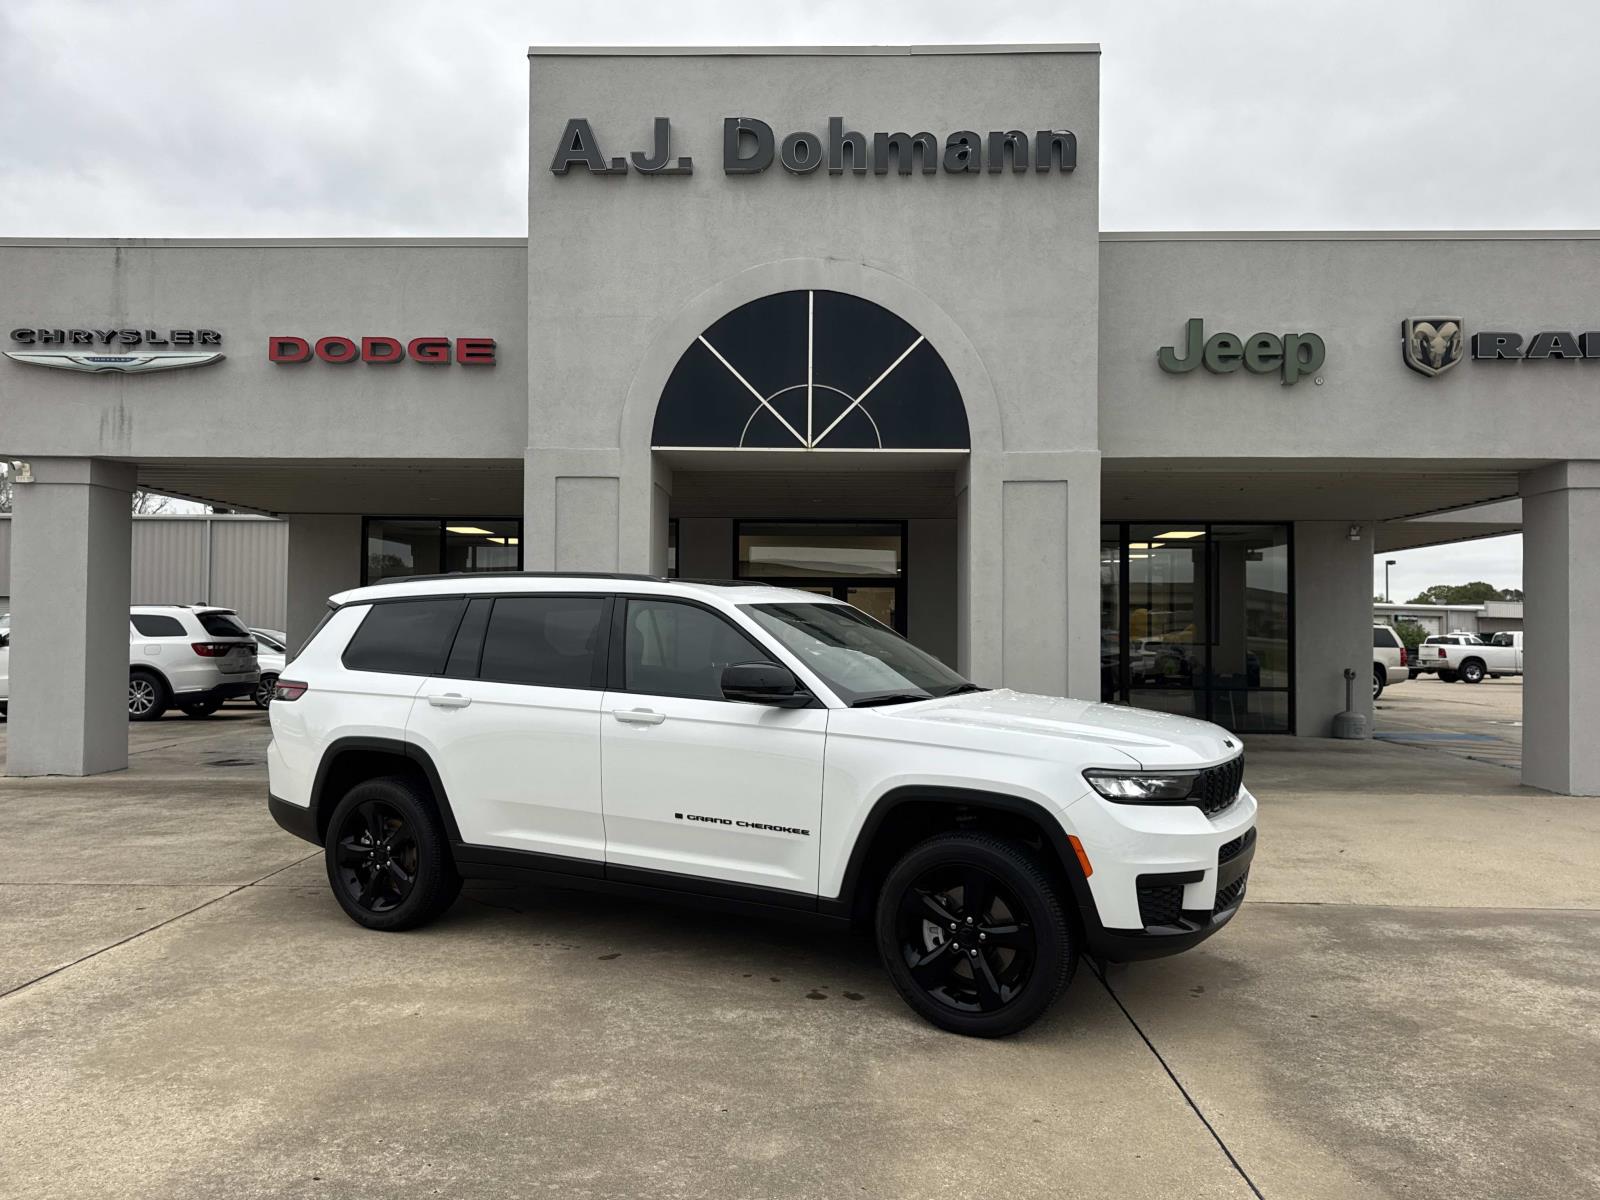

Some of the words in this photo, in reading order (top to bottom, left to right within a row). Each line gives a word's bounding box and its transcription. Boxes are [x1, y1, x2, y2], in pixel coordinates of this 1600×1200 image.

[550, 117, 693, 176] A.J.
[723, 116, 1078, 176] Dohmann
[10, 328, 222, 345] CHRYSLER
[268, 336, 497, 365] DODGE
[1471, 331, 1600, 360] RA
[1157, 318, 1326, 386] Jeep
[686, 814, 732, 826] GRAND
[735, 820, 810, 836] CHEROKEE
